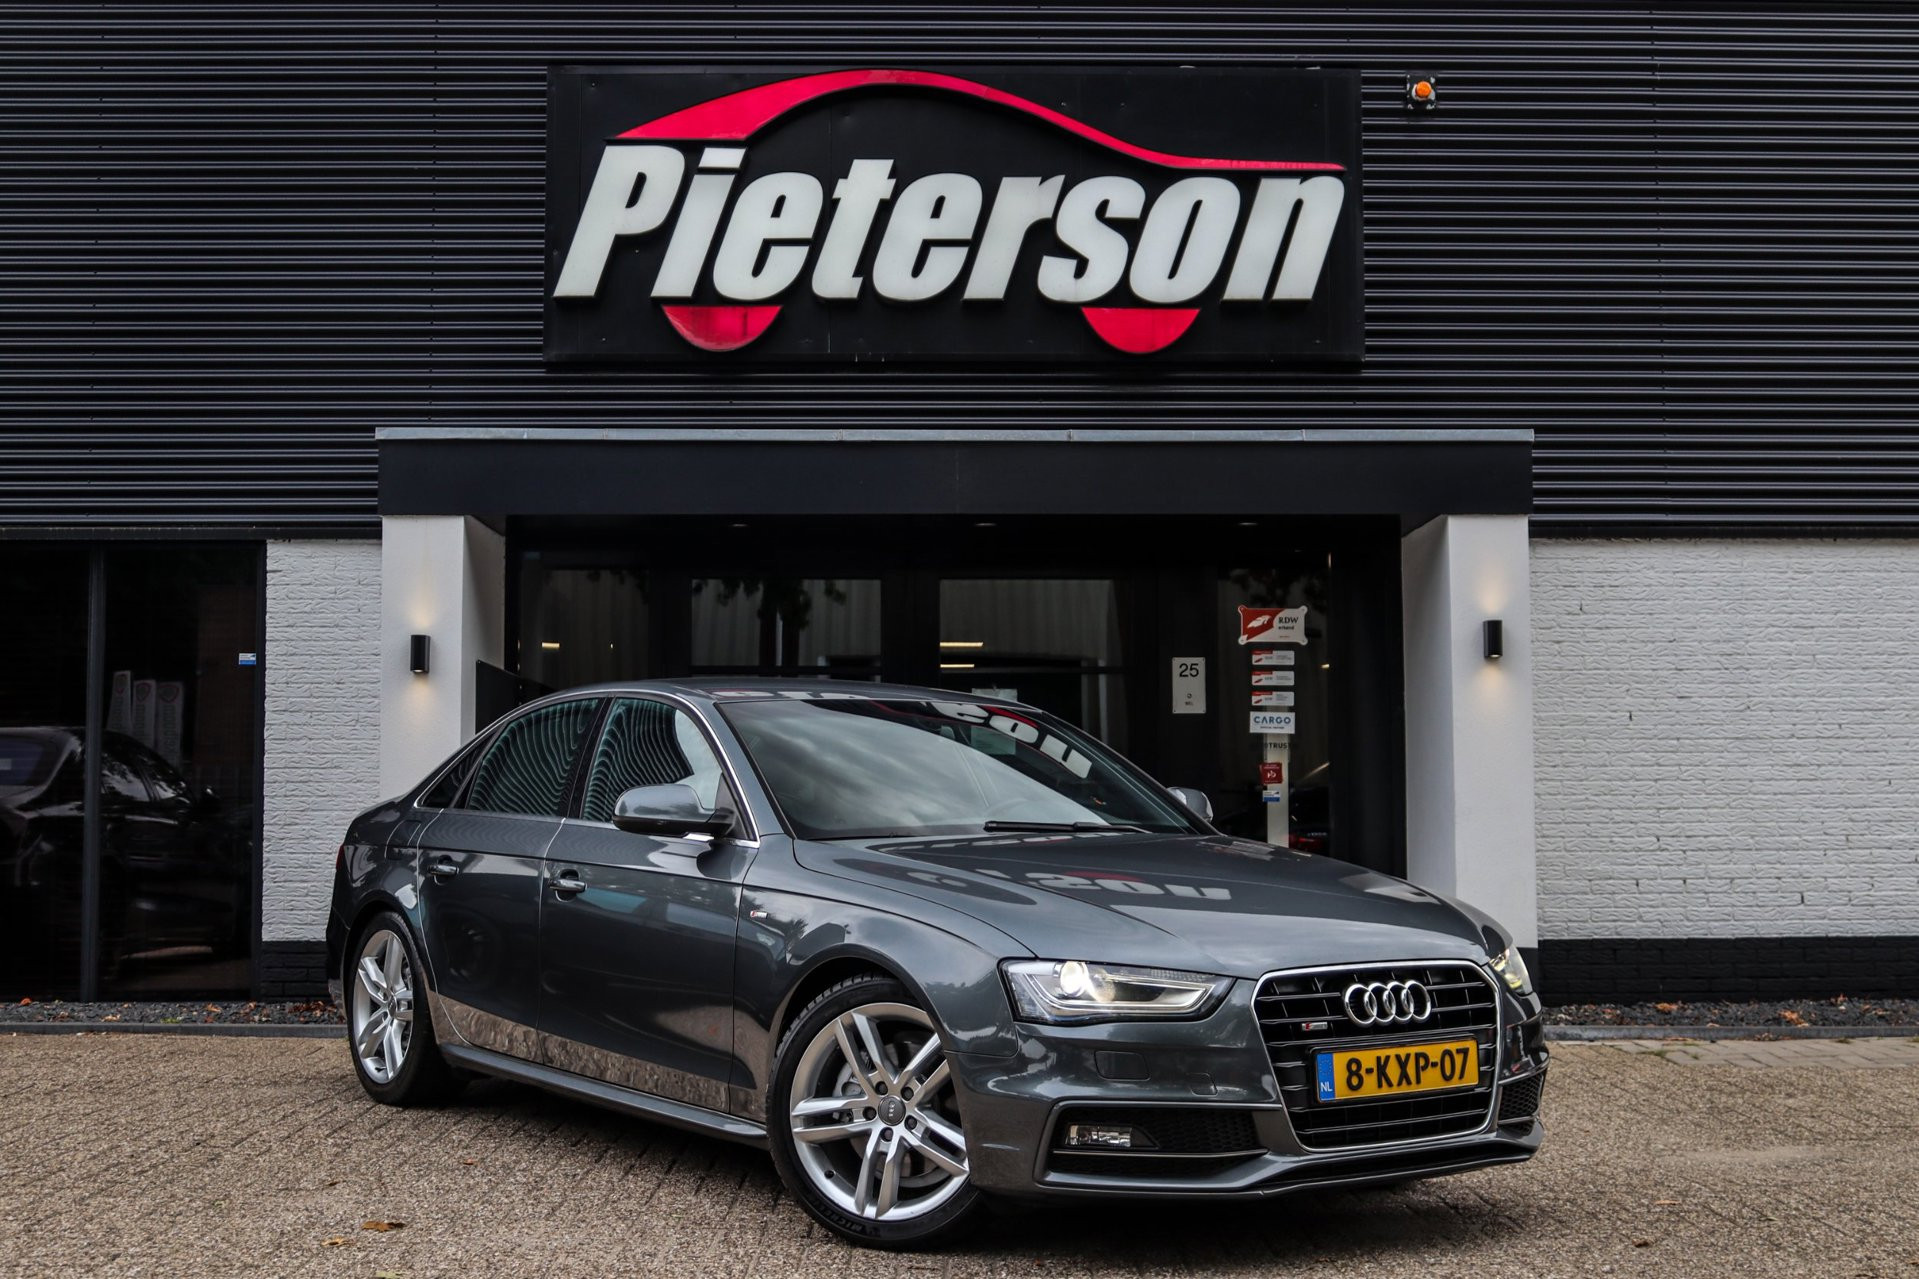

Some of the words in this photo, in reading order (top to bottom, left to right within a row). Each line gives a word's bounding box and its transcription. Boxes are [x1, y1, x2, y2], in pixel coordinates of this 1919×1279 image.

[553, 145, 1345, 303] Pieterson
[1279, 616, 1299, 624] RDW
[1179, 663, 1199, 678] 25
[1254, 716, 1291, 724] CARGO
[1346, 1047, 1470, 1091] 8-KXP-07
[1320, 1081, 1333, 1092] NL
